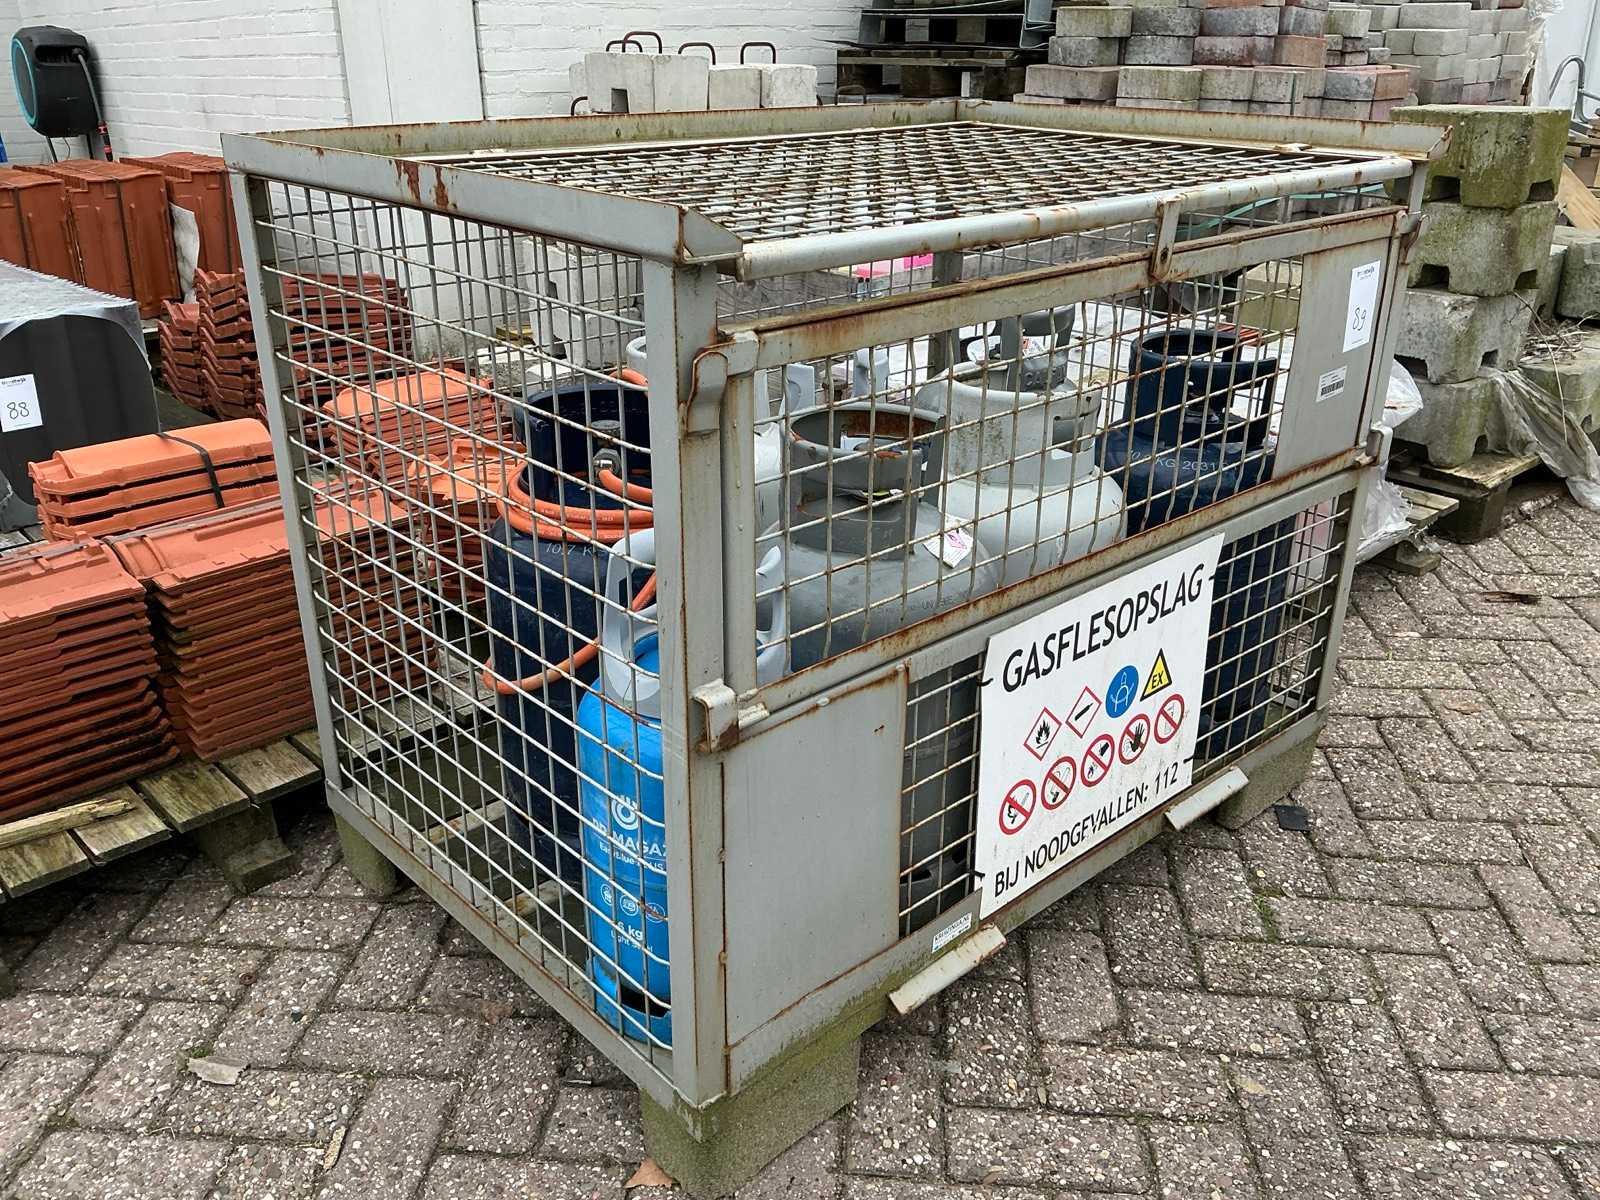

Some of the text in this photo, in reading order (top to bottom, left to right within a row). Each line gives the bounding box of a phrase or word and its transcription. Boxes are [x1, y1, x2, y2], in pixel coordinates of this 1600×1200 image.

[1352, 306, 1367, 331] 89
[6, 401, 30, 420] 88
[1002, 563, 1205, 693] GASFLESOPSLAG
[1151, 669, 1165, 689] EX
[994, 762, 1179, 898] BIJ NOODGEVALLEN: 112
[628, 925, 643, 940] kg
